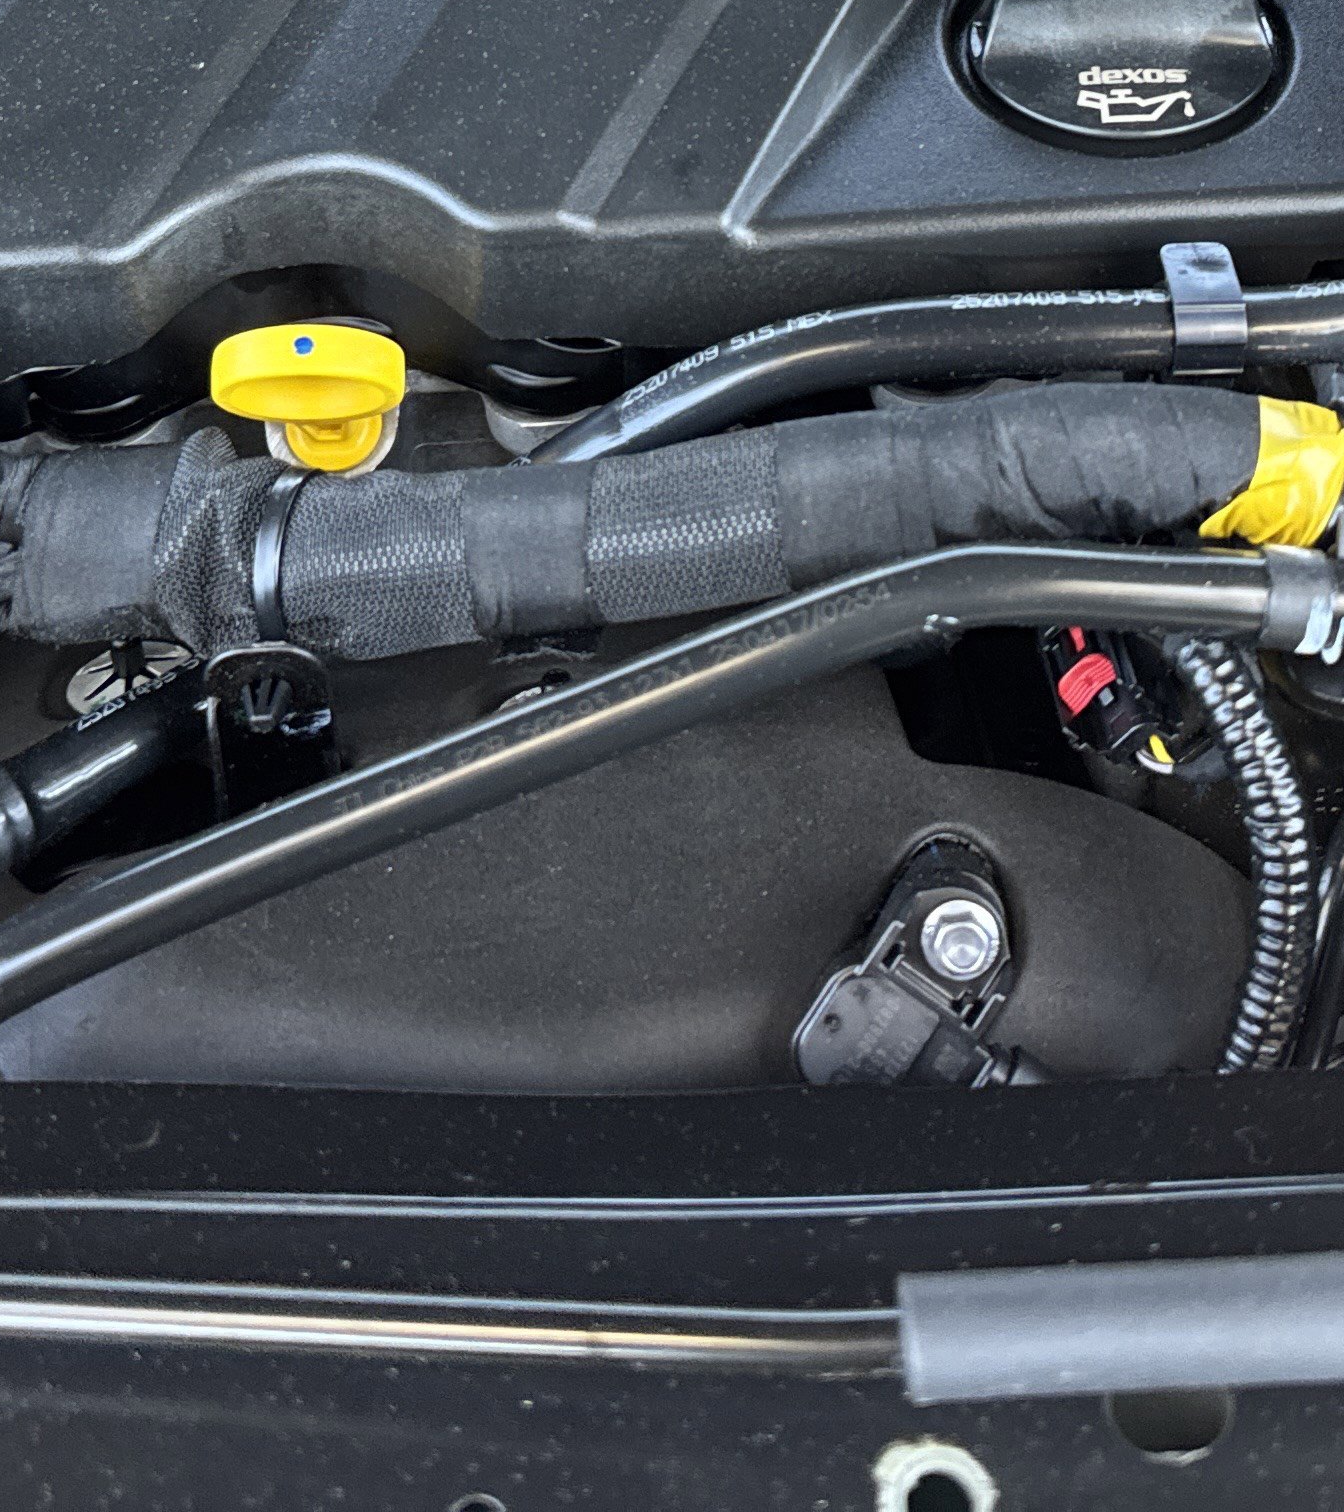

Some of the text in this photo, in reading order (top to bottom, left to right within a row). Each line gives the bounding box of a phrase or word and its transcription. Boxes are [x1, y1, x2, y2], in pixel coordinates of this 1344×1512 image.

[1077, 65, 1190, 86] dexos
[1077, 290, 1123, 305] 515
[621, 309, 834, 410] 25207409 515 MEX
